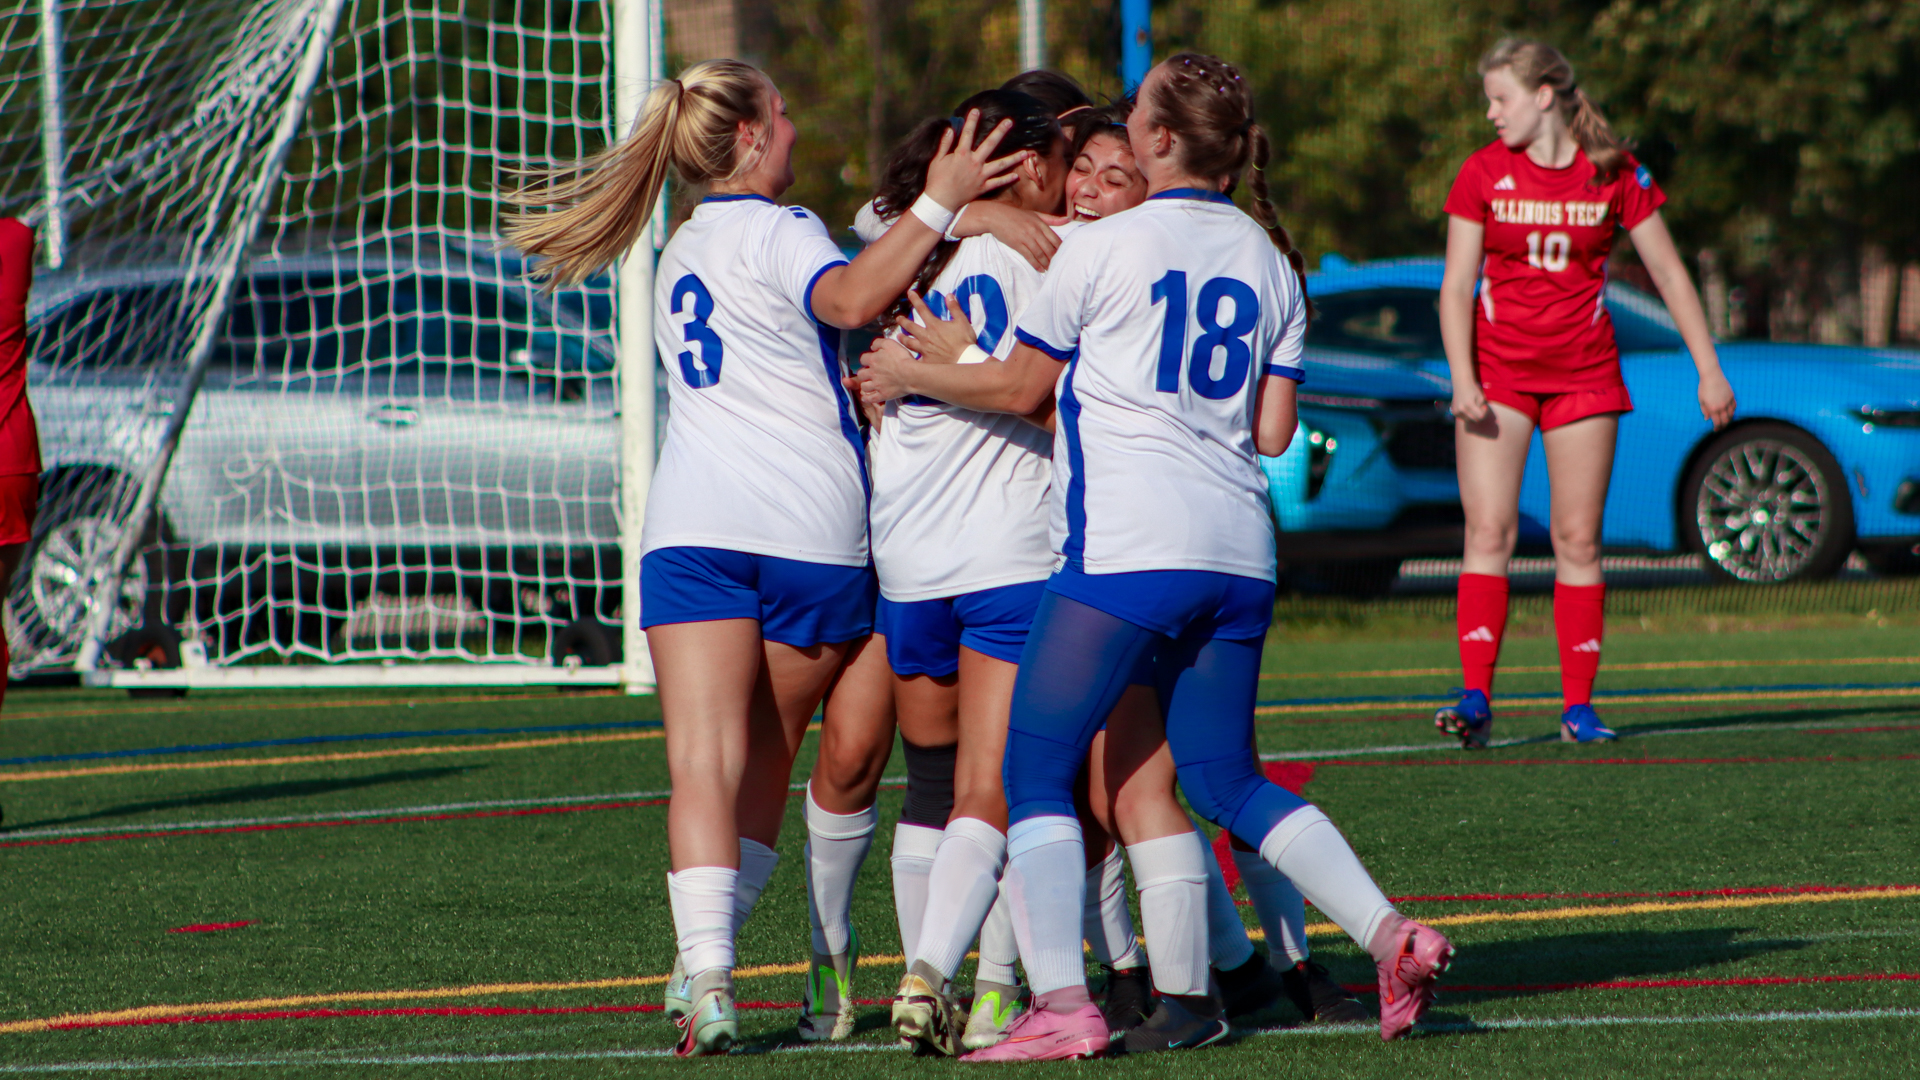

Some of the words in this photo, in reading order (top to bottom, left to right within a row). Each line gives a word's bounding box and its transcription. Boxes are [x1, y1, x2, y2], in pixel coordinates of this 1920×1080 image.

[1491, 199, 1562, 225] ILLINOIS
[1526, 231, 1571, 272] 10
[671, 273, 723, 389] 3
[1151, 270, 1259, 400] 18
